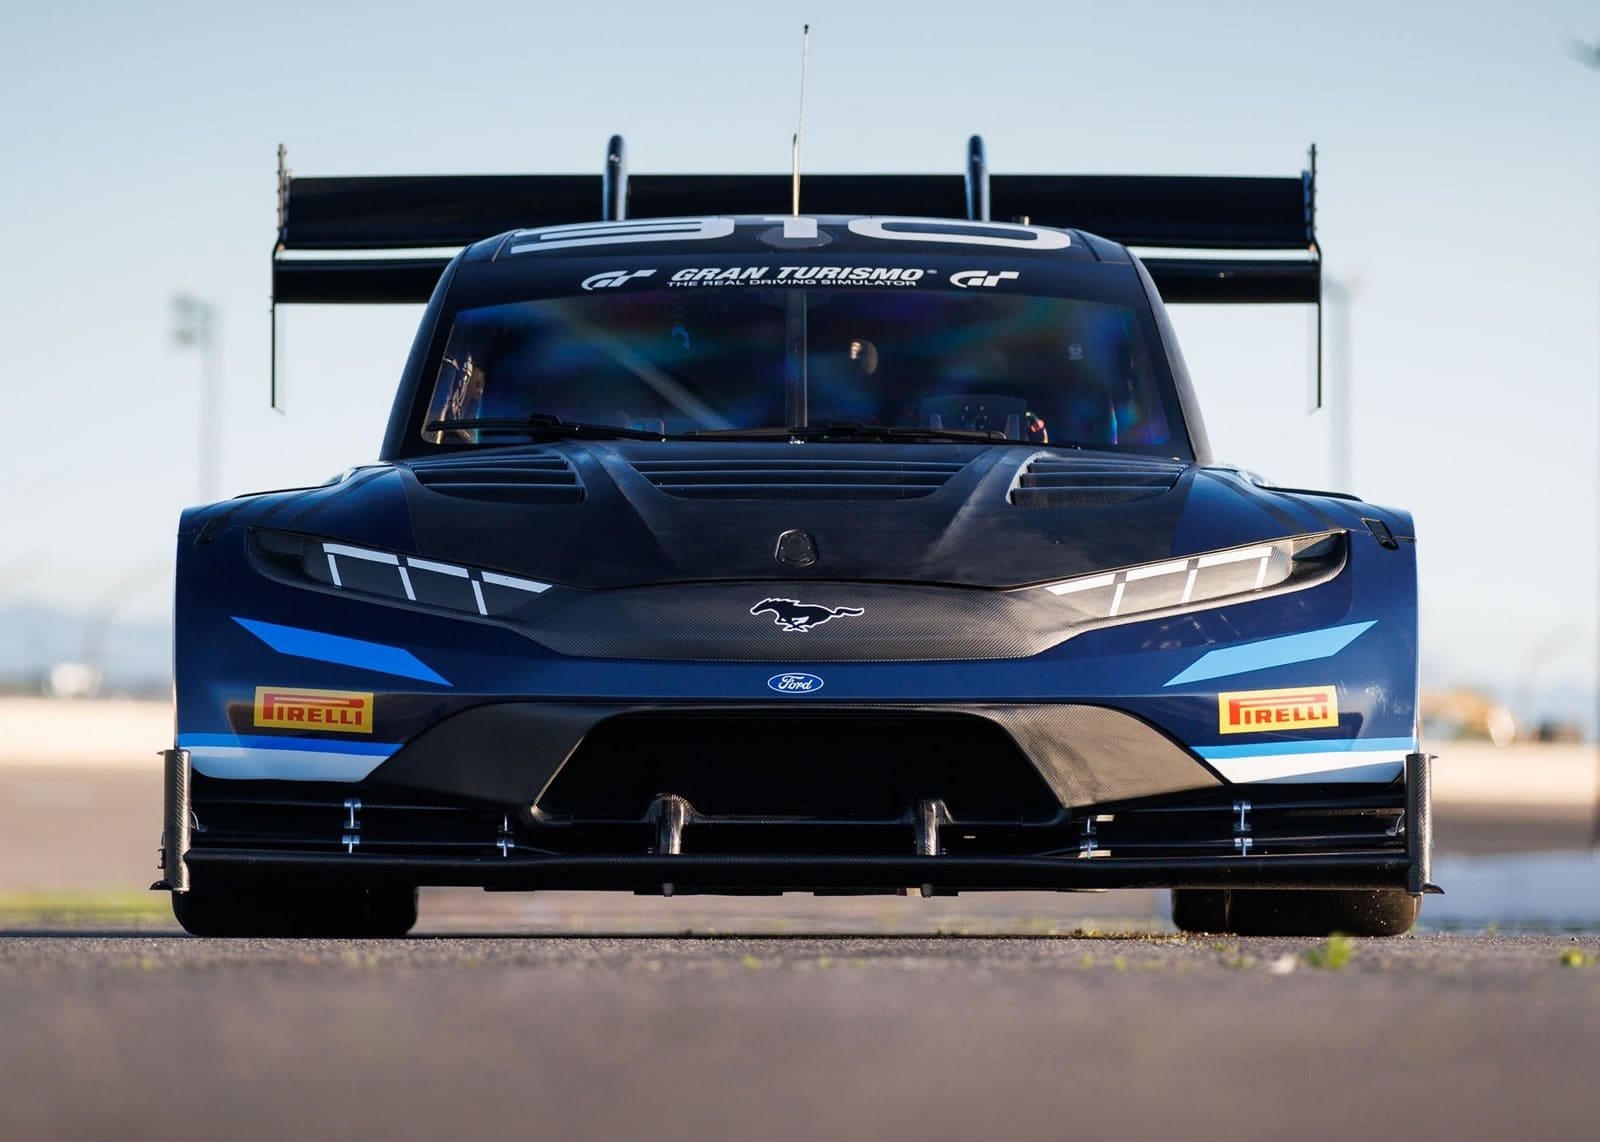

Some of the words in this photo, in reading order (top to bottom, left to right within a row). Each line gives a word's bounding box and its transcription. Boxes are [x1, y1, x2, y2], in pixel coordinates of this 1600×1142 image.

[671, 266, 769, 281] GRAN
[821, 279, 917, 287] SIMULATOR
[778, 675, 813, 690] Ford
[263, 693, 365, 725] PIRELLI
[1229, 693, 1328, 726] PIRELLI
